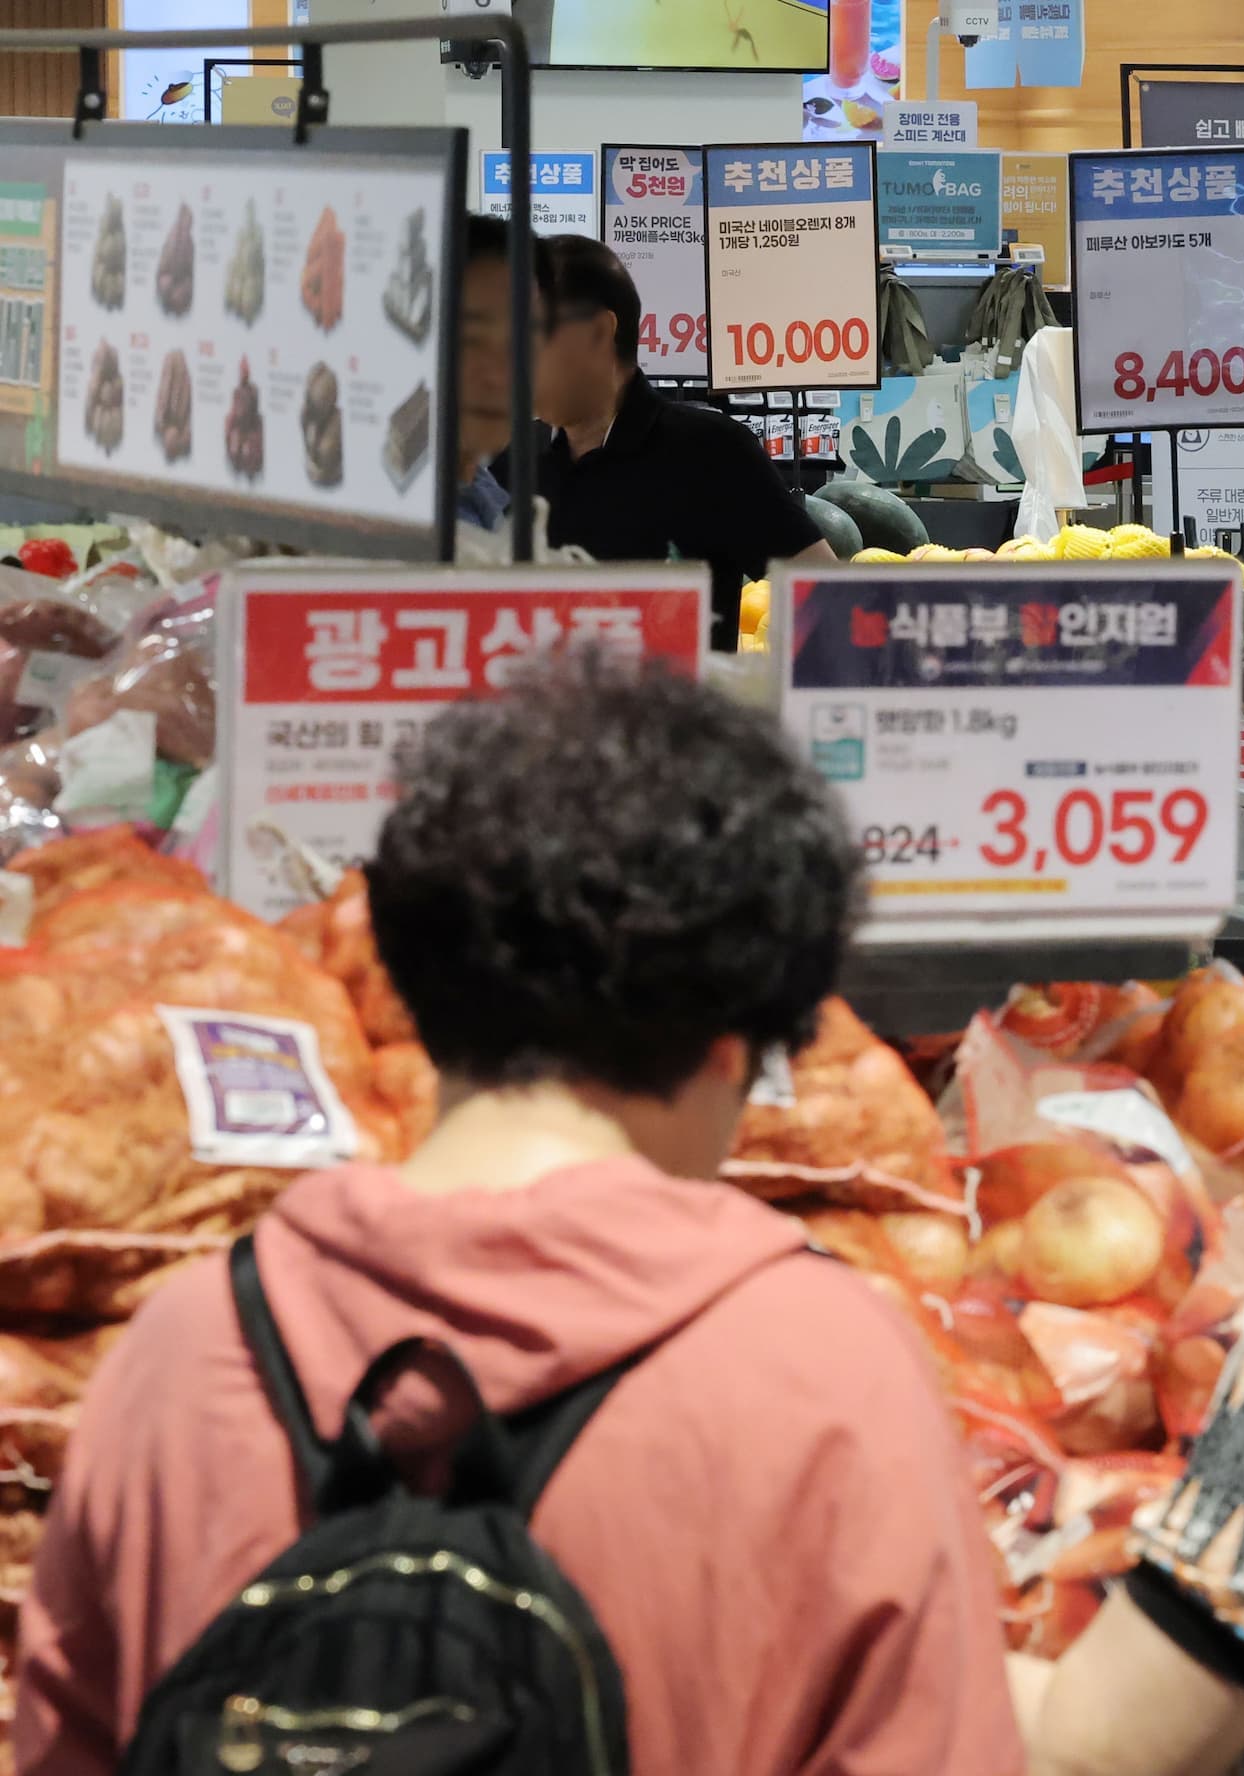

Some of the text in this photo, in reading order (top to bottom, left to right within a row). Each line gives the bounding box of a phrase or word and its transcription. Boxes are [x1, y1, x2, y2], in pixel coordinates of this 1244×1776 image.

[965, 17, 989, 25] CCTV
[898, 112, 961, 127] 장애인 전용
[893, 129, 966, 143] 스피드 계산대
[1195, 119, 1230, 140] 쉽고
[619, 156, 680, 172] 막 집어도
[722, 157, 854, 194] 추천상품
[626, 173, 686, 199] 5천원
[945, 182, 982, 197] BAG
[1092, 165, 1237, 206] 추천상품
[613, 215, 691, 230] A) 5K PRICE
[719, 214, 856, 235] 미국산 네이블오렌지 8개
[720, 234, 799, 250] 1개당 1,250원
[1086, 232, 1212, 252] 페루산 아보카도 5개
[726, 316, 870, 368] 10,000
[808, 421, 839, 432] Energizer
[1197, 488, 1222, 504] 주류
[951, 707, 1017, 739] 1.8kg
[979, 788, 1210, 873] 3,059
